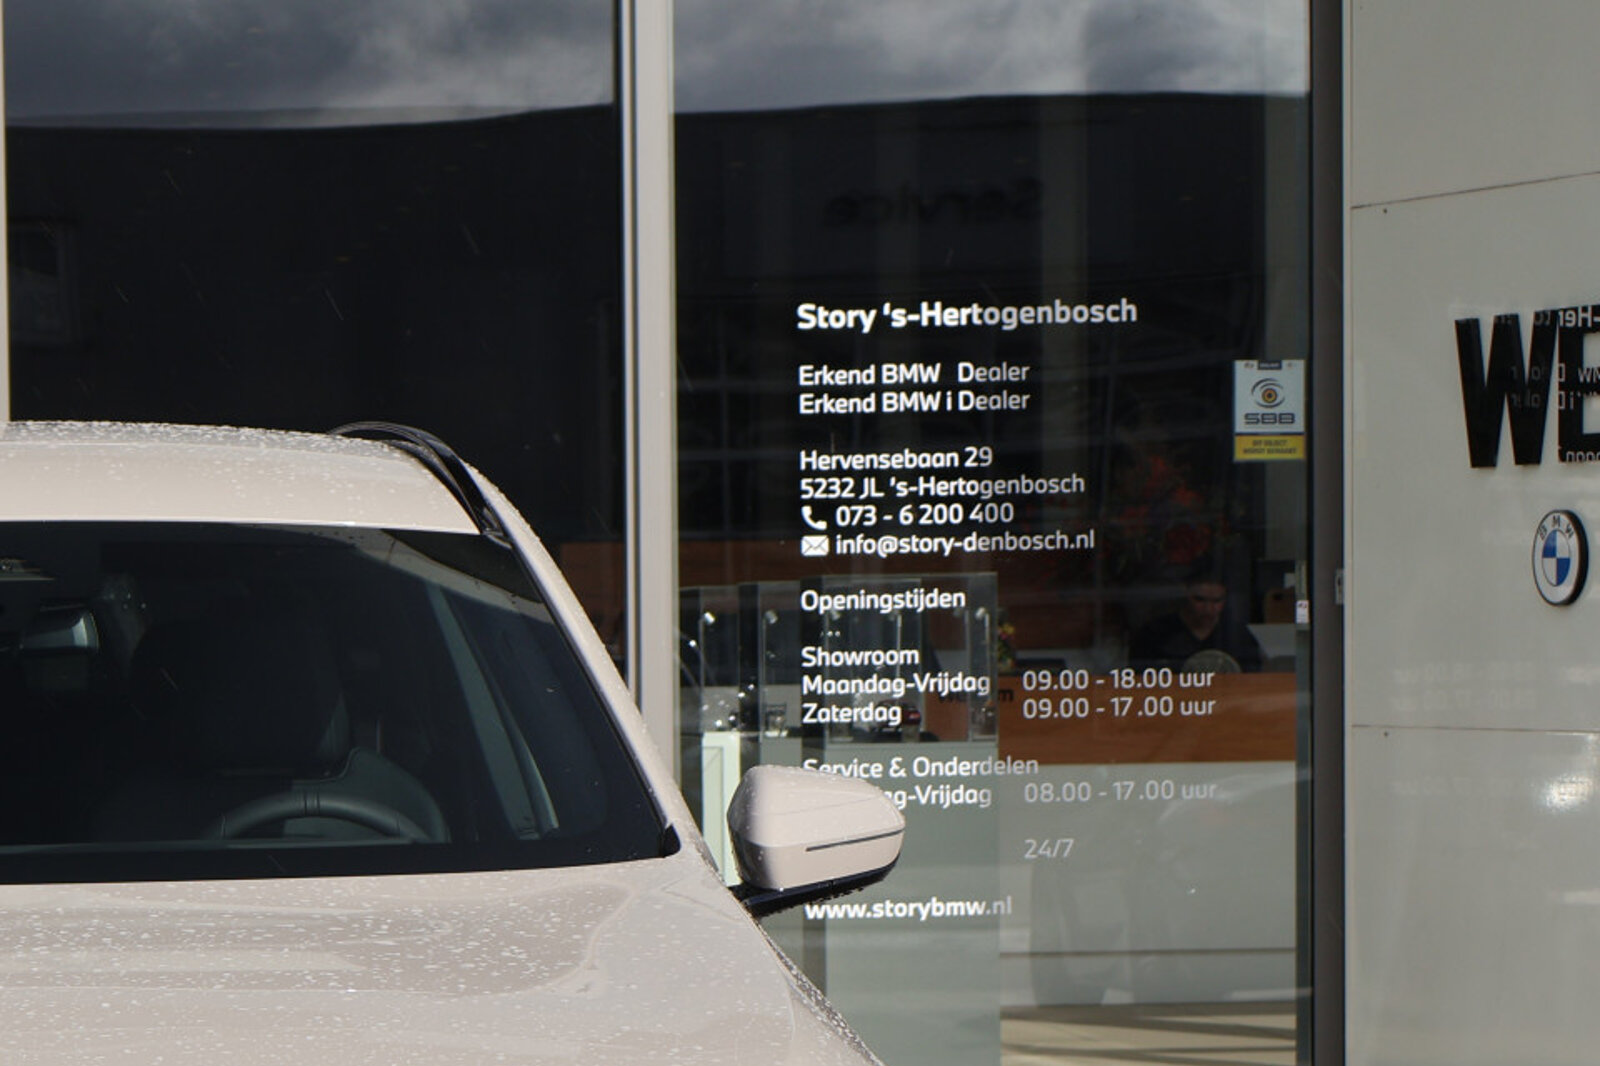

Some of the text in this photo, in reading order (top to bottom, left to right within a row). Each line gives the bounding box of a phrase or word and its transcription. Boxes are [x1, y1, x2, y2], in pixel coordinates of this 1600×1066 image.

[798, 304, 876, 333] Story
[799, 362, 1030, 385] Erkend BMW Dealer
[799, 391, 1030, 414] Erkend BMW i Dealer
[800, 447, 992, 470] Hervensebaan 29
[801, 478, 855, 499] 5232
[860, 478, 884, 499] JL
[836, 506, 876, 526] 073
[900, 505, 912, 525] 6
[919, 504, 963, 524] 200
[969, 503, 1014, 523] 400
[836, 530, 1095, 557] info@story-denbosch.nl
[801, 589, 965, 615] Openingstijden
[801, 646, 919, 669] Showroom
[803, 673, 990, 697] Maandag-Vrijdag
[1022, 669, 1088, 691] 09.00
[1110, 668, 1172, 688] 18.00
[1179, 671, 1214, 687] uur
[803, 703, 901, 727] Zaterdag
[1022, 698, 1088, 719] 09.00
[1179, 700, 1216, 716] uur
[890, 757, 906, 777] &
[913, 756, 1038, 777] Onderdelen
[1024, 783, 1090, 803] 08.00
[1182, 784, 1217, 799] uur
[1024, 838, 1074, 858] 24/7
[805, 898, 1012, 922] www.storybmw.nl
